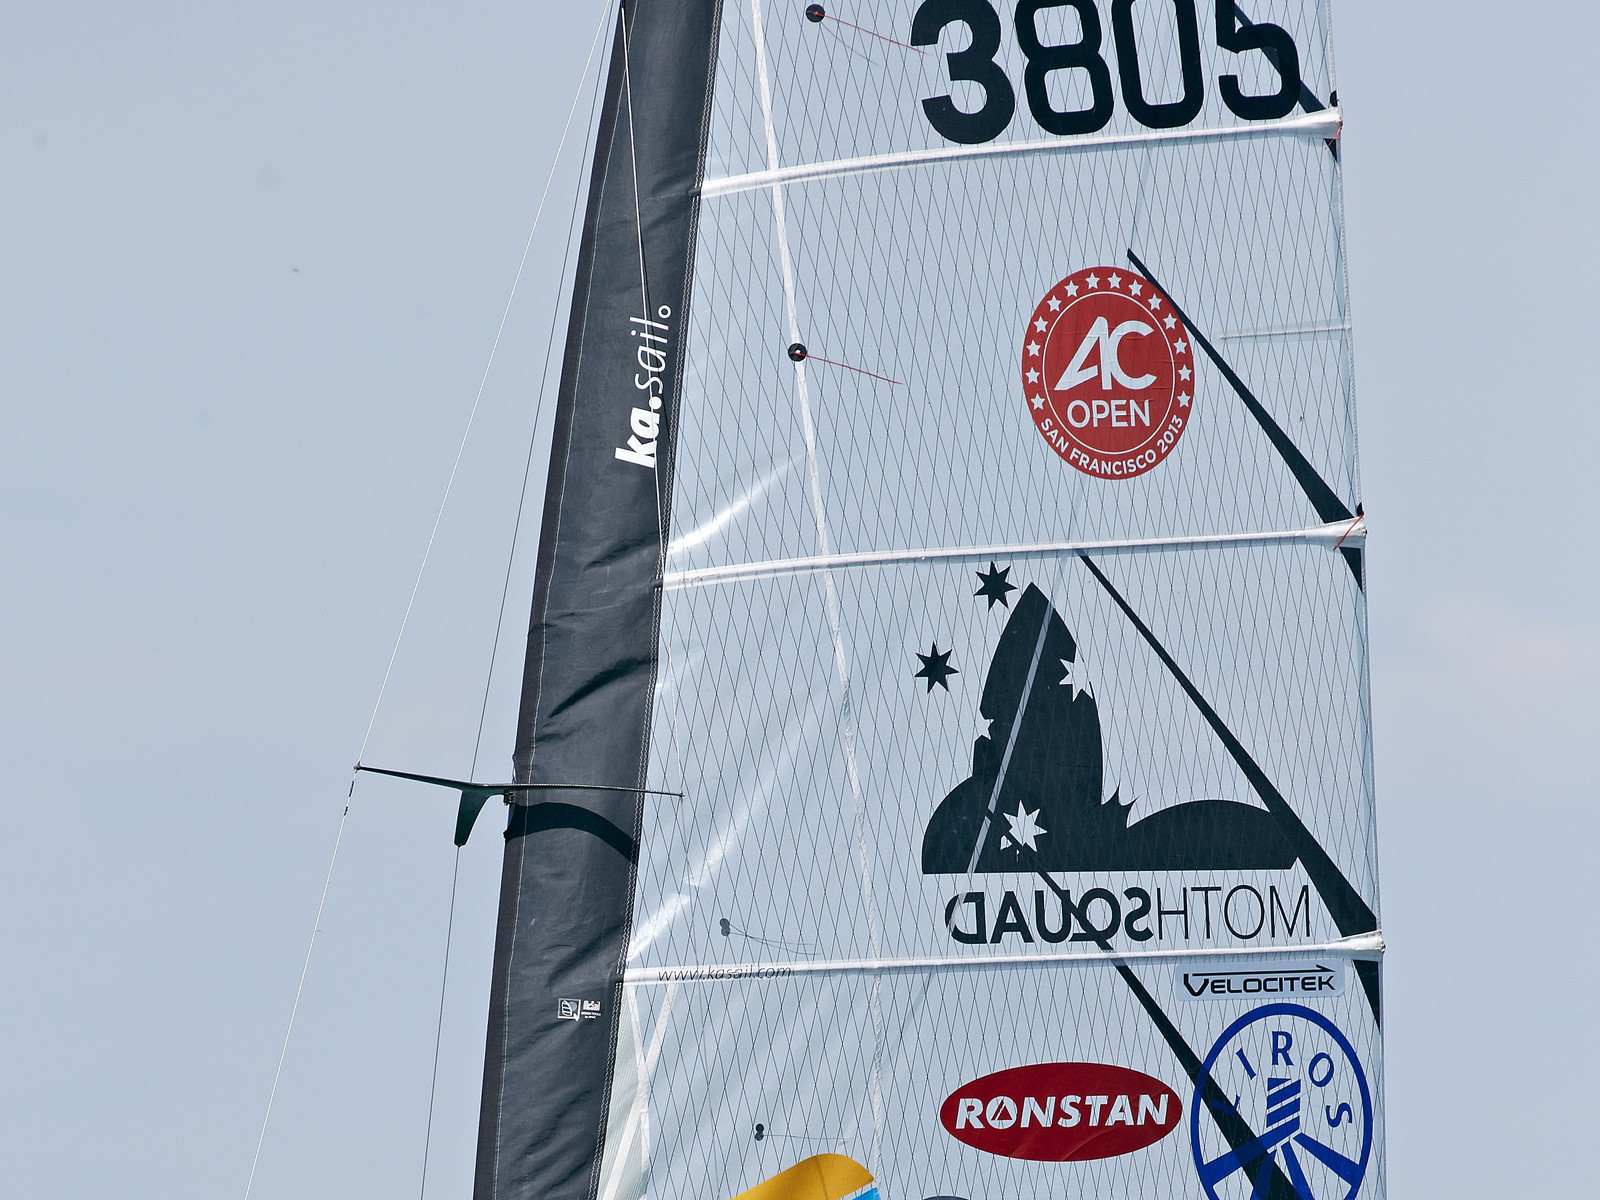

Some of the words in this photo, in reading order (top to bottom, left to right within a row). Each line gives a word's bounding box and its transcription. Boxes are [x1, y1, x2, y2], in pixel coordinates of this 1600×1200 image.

[910, 0, 1300, 144] 3805
[1053, 316, 1158, 391] AC
[1066, 399, 1151, 429] OPEN
[1040, 418, 1069, 453] SAN
[1069, 447, 1157, 475] FRANCISCO
[1156, 414, 1184, 454] 2013
[1183, 972, 1336, 998] VELOCITEK
[955, 1093, 1169, 1130] RONSTAN
